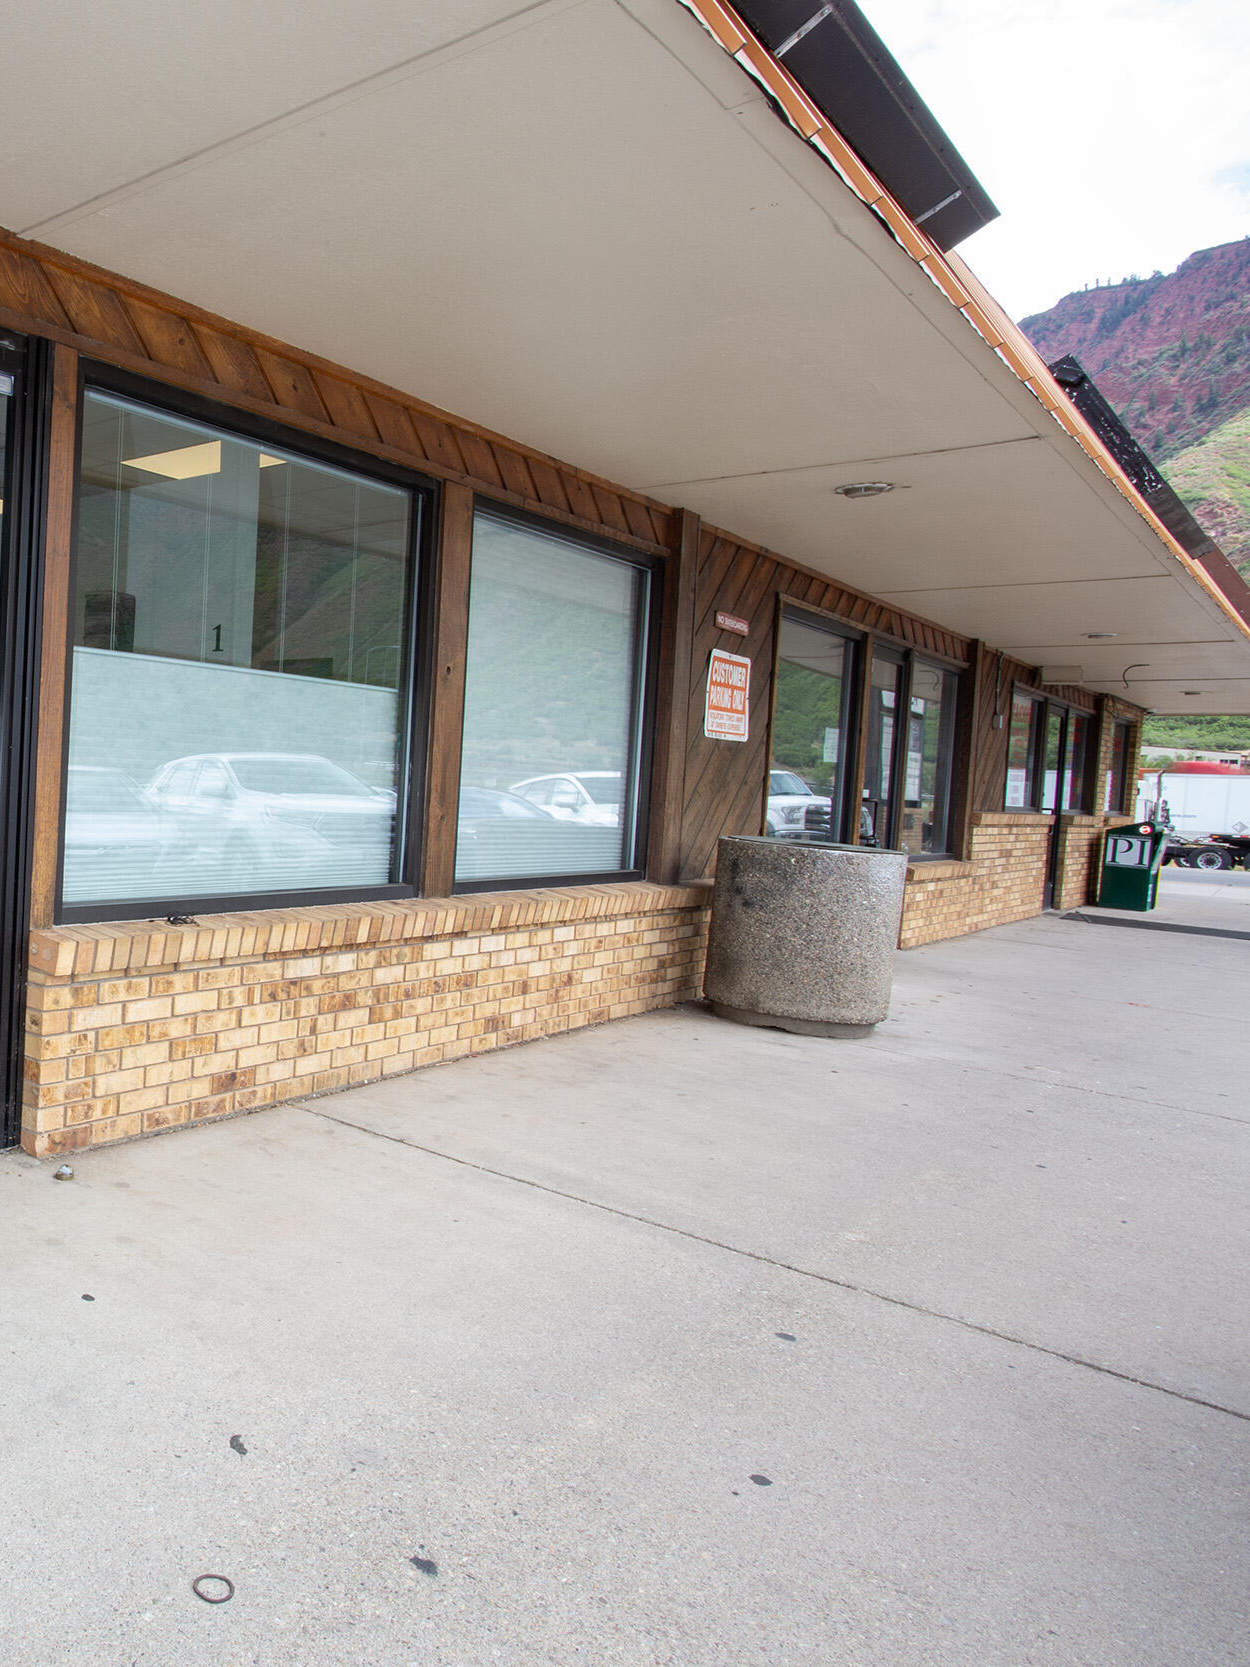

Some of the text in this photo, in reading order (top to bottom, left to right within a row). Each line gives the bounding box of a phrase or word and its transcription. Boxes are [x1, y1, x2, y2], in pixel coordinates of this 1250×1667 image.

[212, 623, 224, 652] 1
[712, 660, 746, 688] CUSTOMER
[1107, 837, 1151, 866] PI
